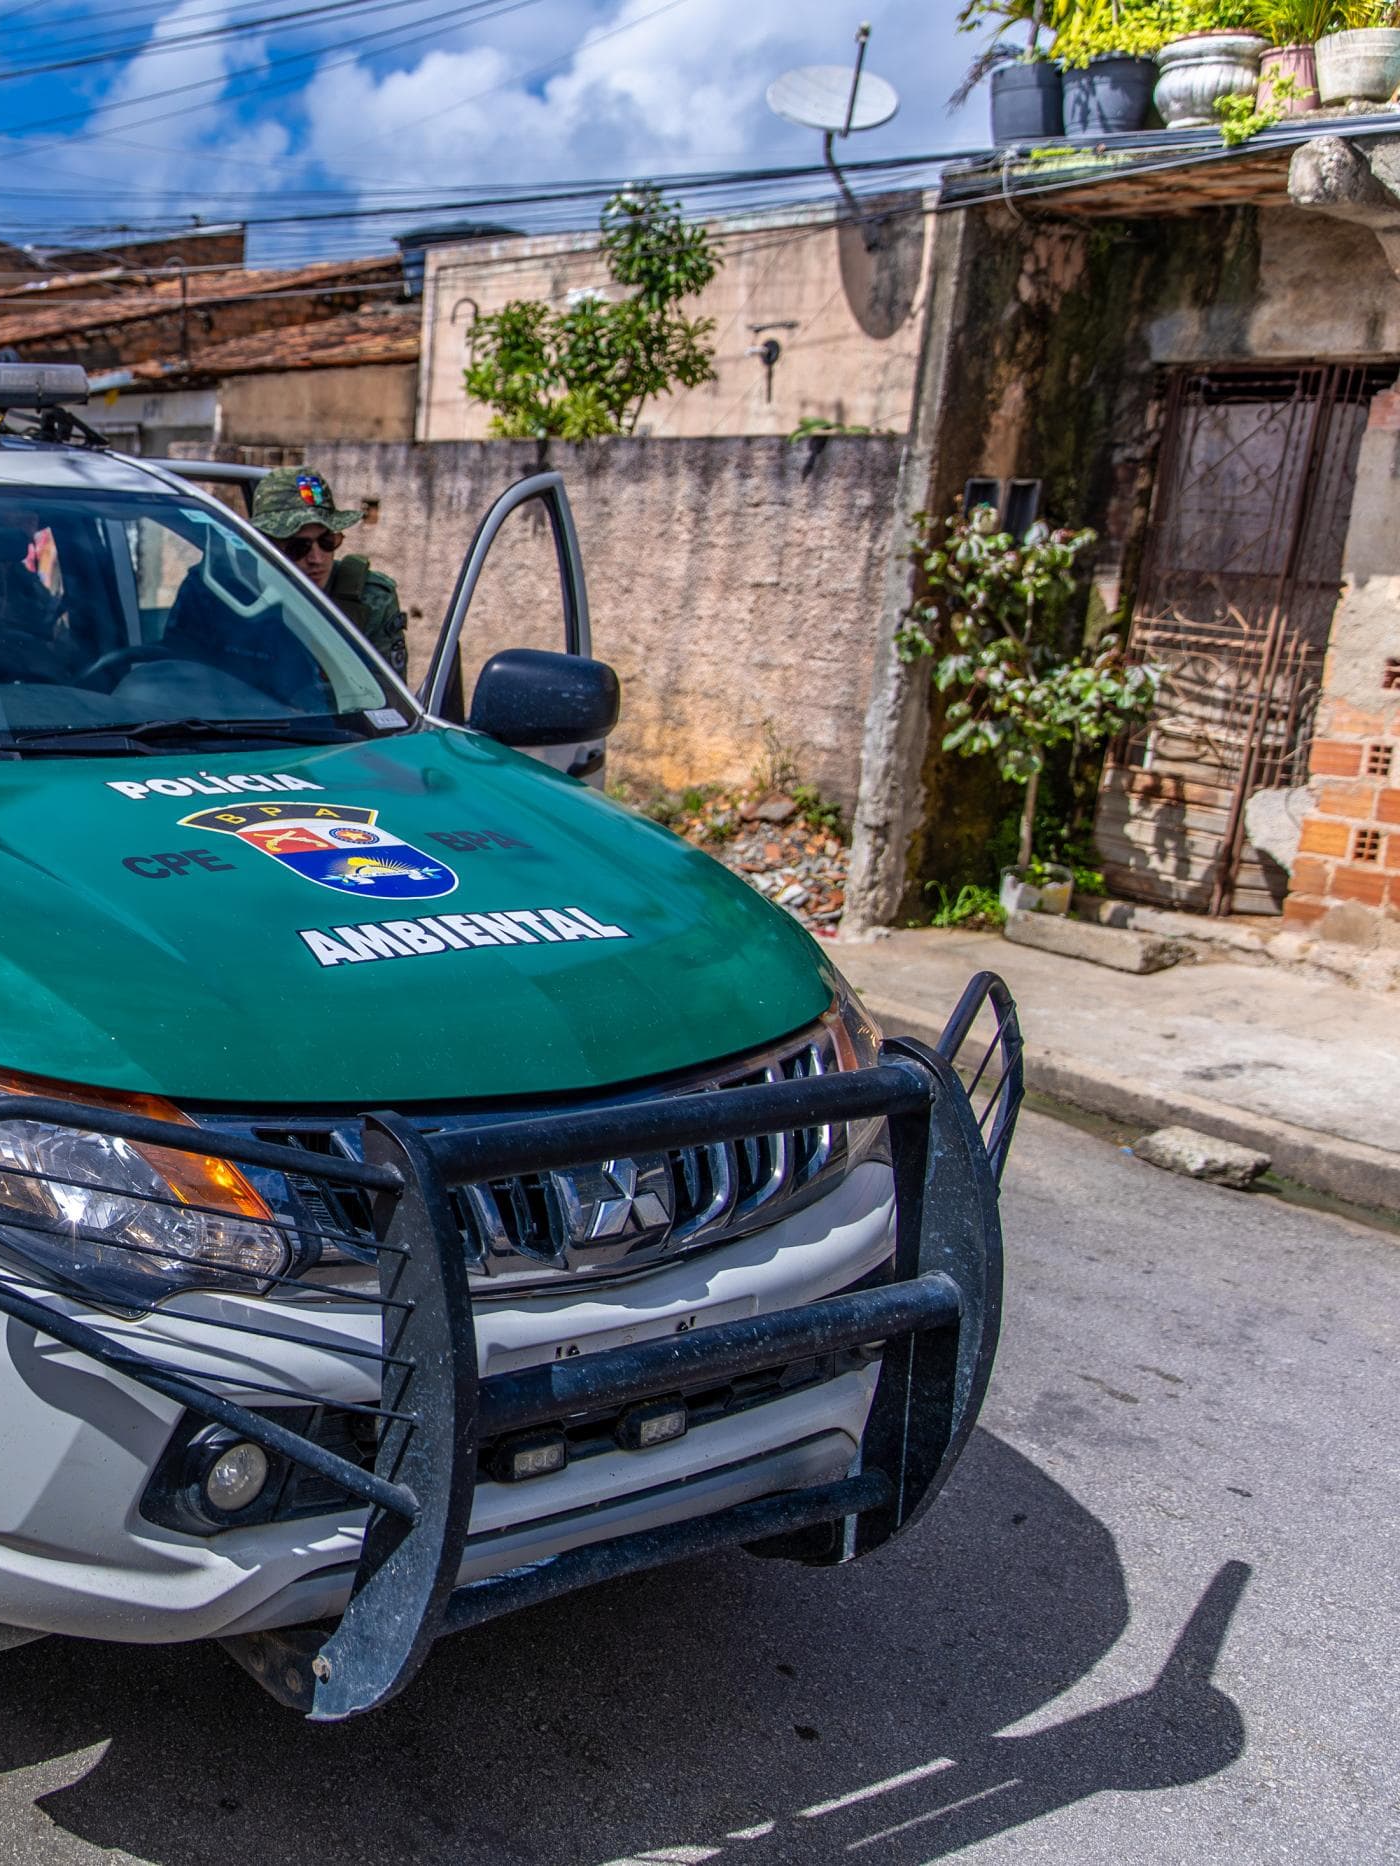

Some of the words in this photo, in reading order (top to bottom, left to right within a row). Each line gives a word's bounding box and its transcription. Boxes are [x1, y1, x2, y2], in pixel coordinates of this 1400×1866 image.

[105, 771, 325, 799] POLÍCIA
[425, 829, 532, 853] BPA
[121, 849, 237, 879] CPE
[298, 906, 632, 967] AMBIENTAL
